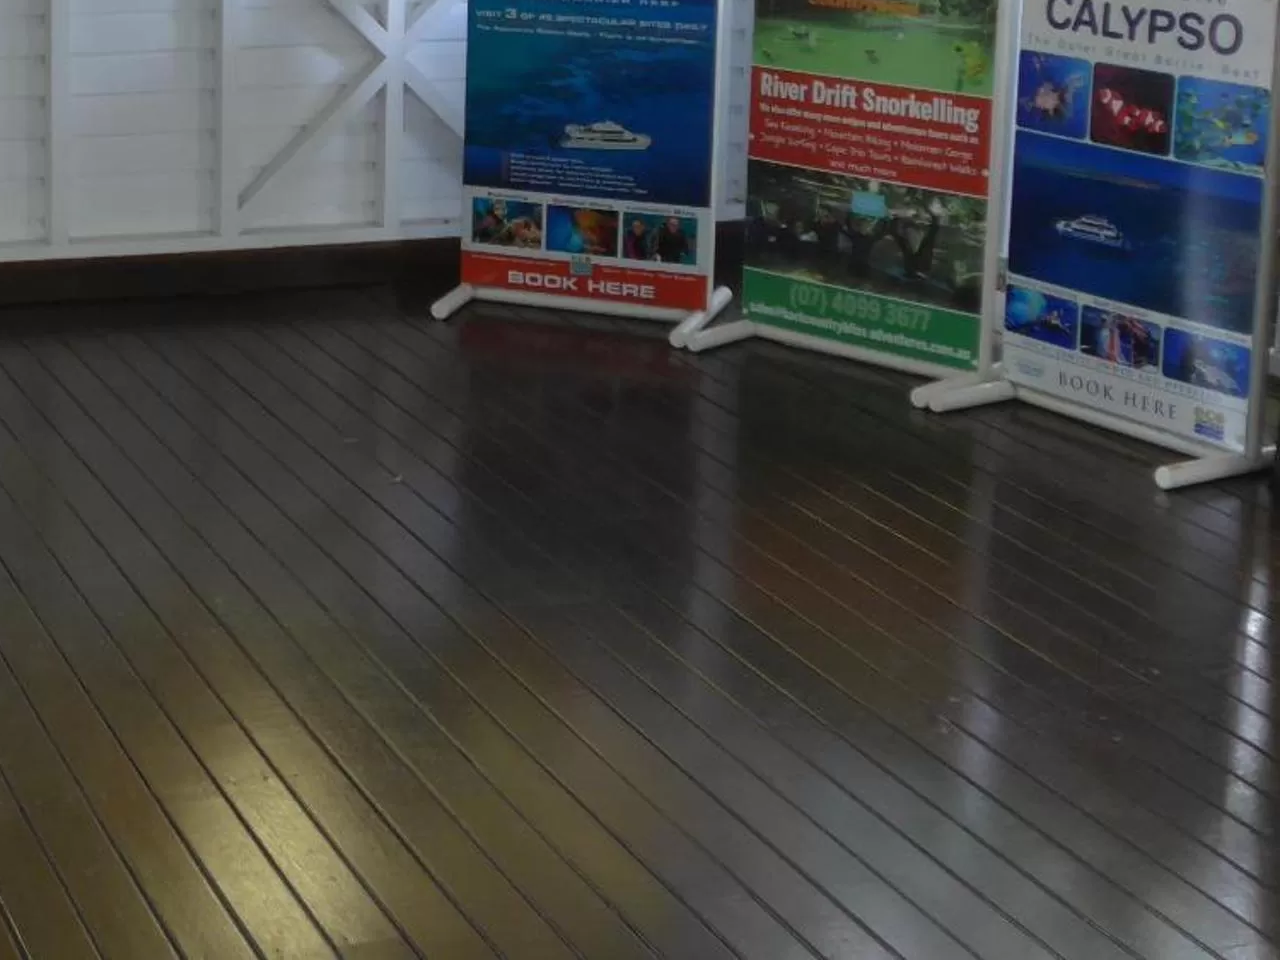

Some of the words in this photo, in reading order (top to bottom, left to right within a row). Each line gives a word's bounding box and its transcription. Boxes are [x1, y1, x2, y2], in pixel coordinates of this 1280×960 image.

[504, 7, 518, 20] 3
[760, 71, 809, 101] River
[812, 79, 858, 109] Drift
[862, 87, 982, 134] Snorkelling
[507, 270, 579, 291] BOOK
[587, 279, 657, 300] HERE
[789, 283, 827, 315] (07)
[830, 293, 883, 323] 4099
[1058, 370, 1115, 403] BOOK
[1123, 393, 1178, 421] HERE
